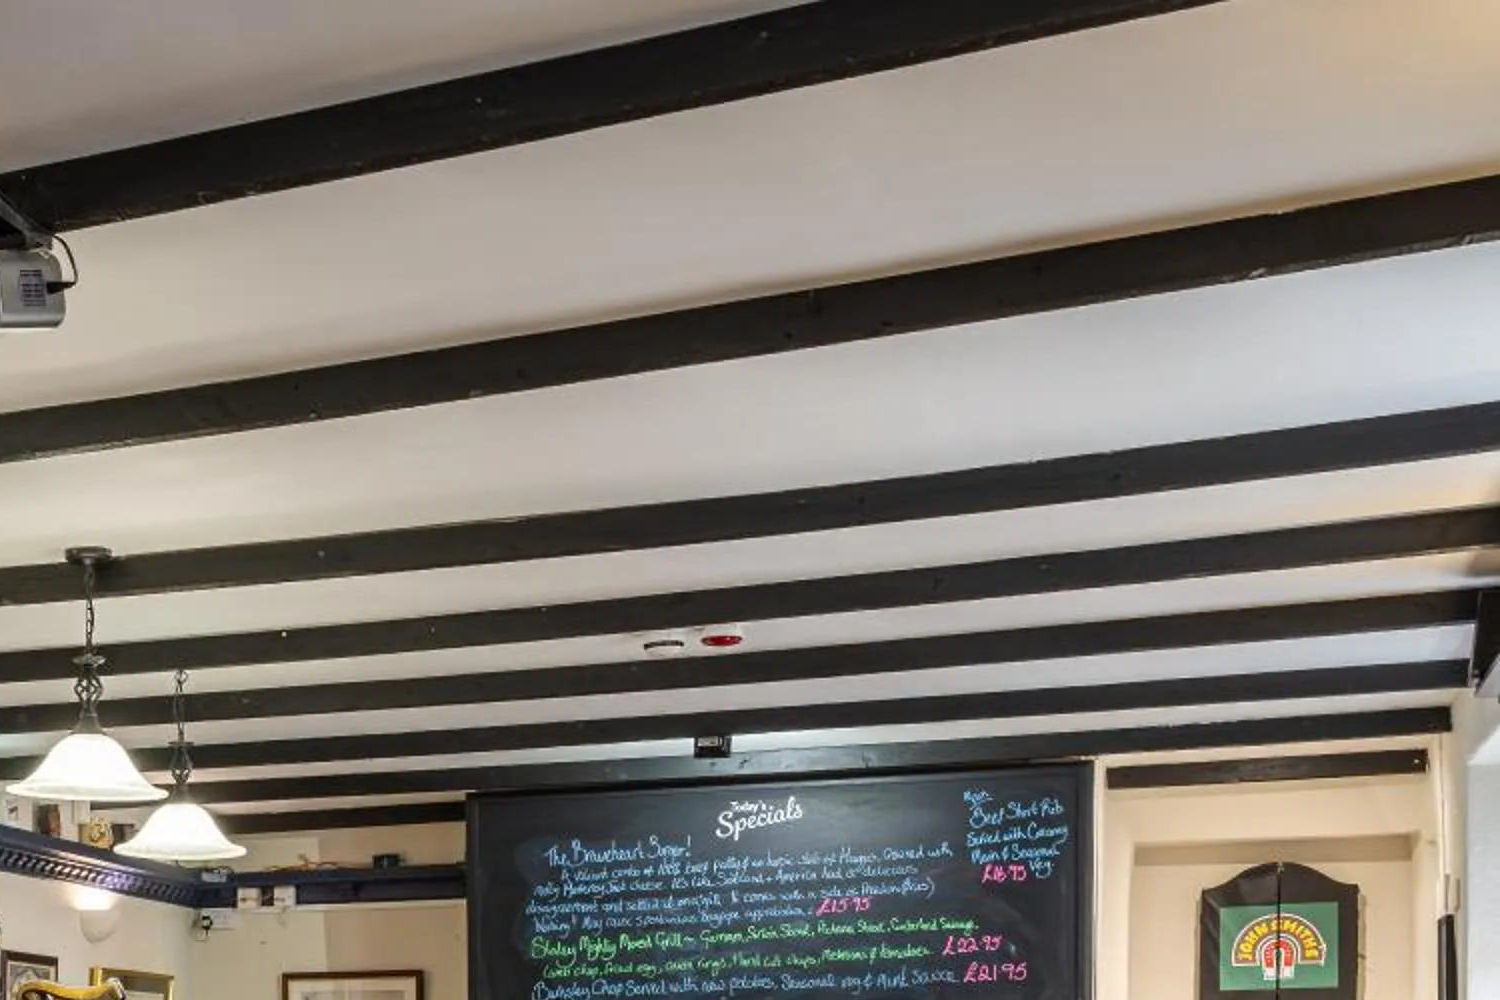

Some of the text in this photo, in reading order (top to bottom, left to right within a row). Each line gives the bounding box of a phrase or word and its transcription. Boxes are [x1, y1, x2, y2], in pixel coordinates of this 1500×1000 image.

[715, 795, 803, 841] Specials
[1003, 826, 1027, 841] with
[542, 845, 566, 868] The
[927, 841, 953, 858] with
[1237, 922, 1269, 961] JOHN
[669, 977, 698, 993] with
[702, 979, 727, 993] new
